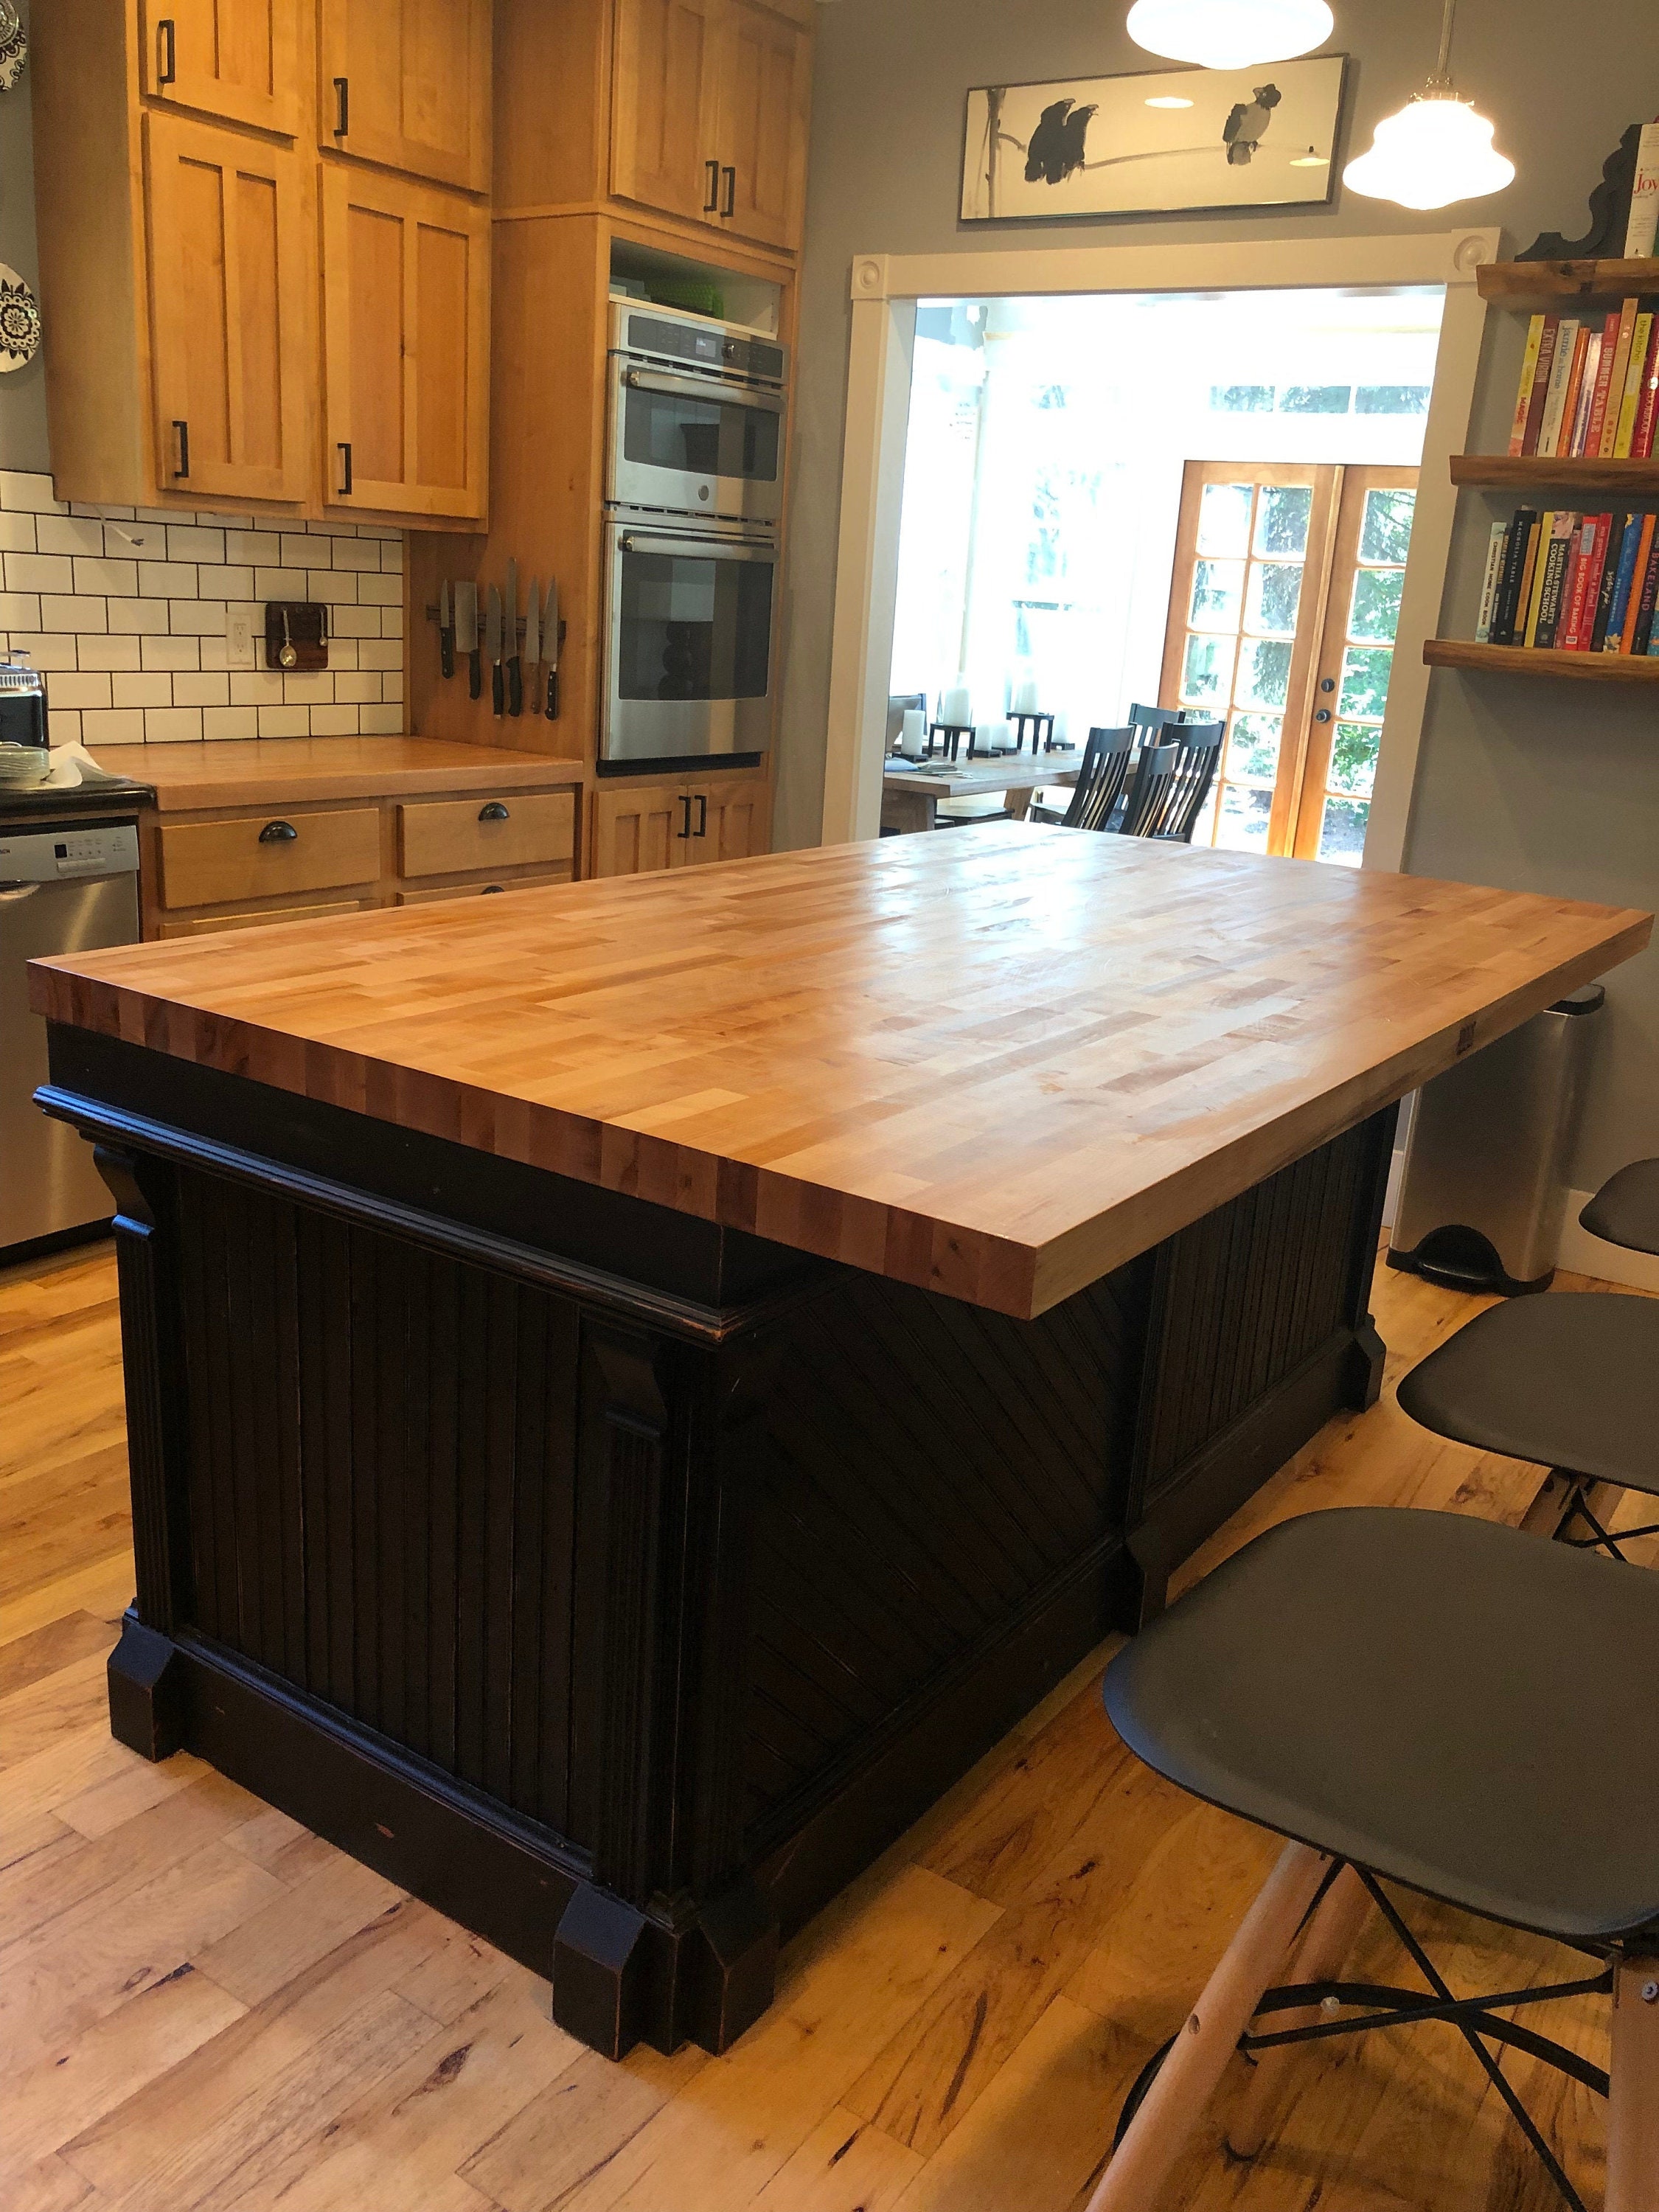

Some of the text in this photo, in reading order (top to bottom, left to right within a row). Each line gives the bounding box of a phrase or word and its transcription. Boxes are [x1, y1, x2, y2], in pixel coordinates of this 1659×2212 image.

[1557, 326, 1573, 357] jamie
[1638, 319, 1647, 334] the
[1534, 327, 1554, 383] EXTRA VIRGIN
[1598, 347, 1613, 388] SUMMER
[1554, 365, 1565, 389] home
[1590, 389, 1607, 433] TABLE
[1489, 541, 1498, 571] CHRISTIAN
[1509, 521, 1523, 582] MAGNOLIA TABLE
[1554, 543, 1565, 579] MARTHA
[1539, 543, 1558, 624] COOKING SCHOOL
[1575, 572, 1585, 594] BOOK
[1545, 580, 1559, 624] STEWART'S
[1573, 595, 1581, 605] OF
[1569, 608, 1579, 633] BAKING
